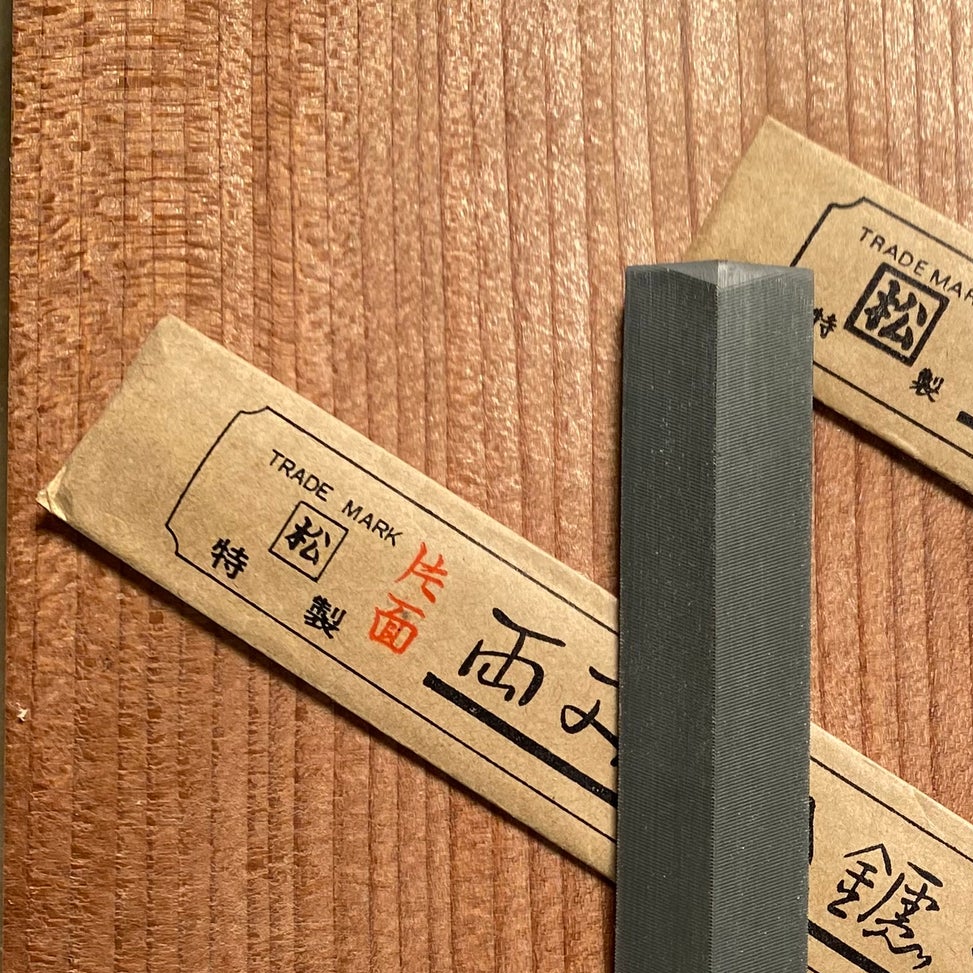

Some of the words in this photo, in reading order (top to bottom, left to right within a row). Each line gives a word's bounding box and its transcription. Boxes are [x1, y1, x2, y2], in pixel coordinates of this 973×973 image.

[860, 228, 926, 276] TRADE
[268, 449, 335, 501] TRADE
[341, 499, 404, 547] MARK
[286, 515, 331, 566] 松
